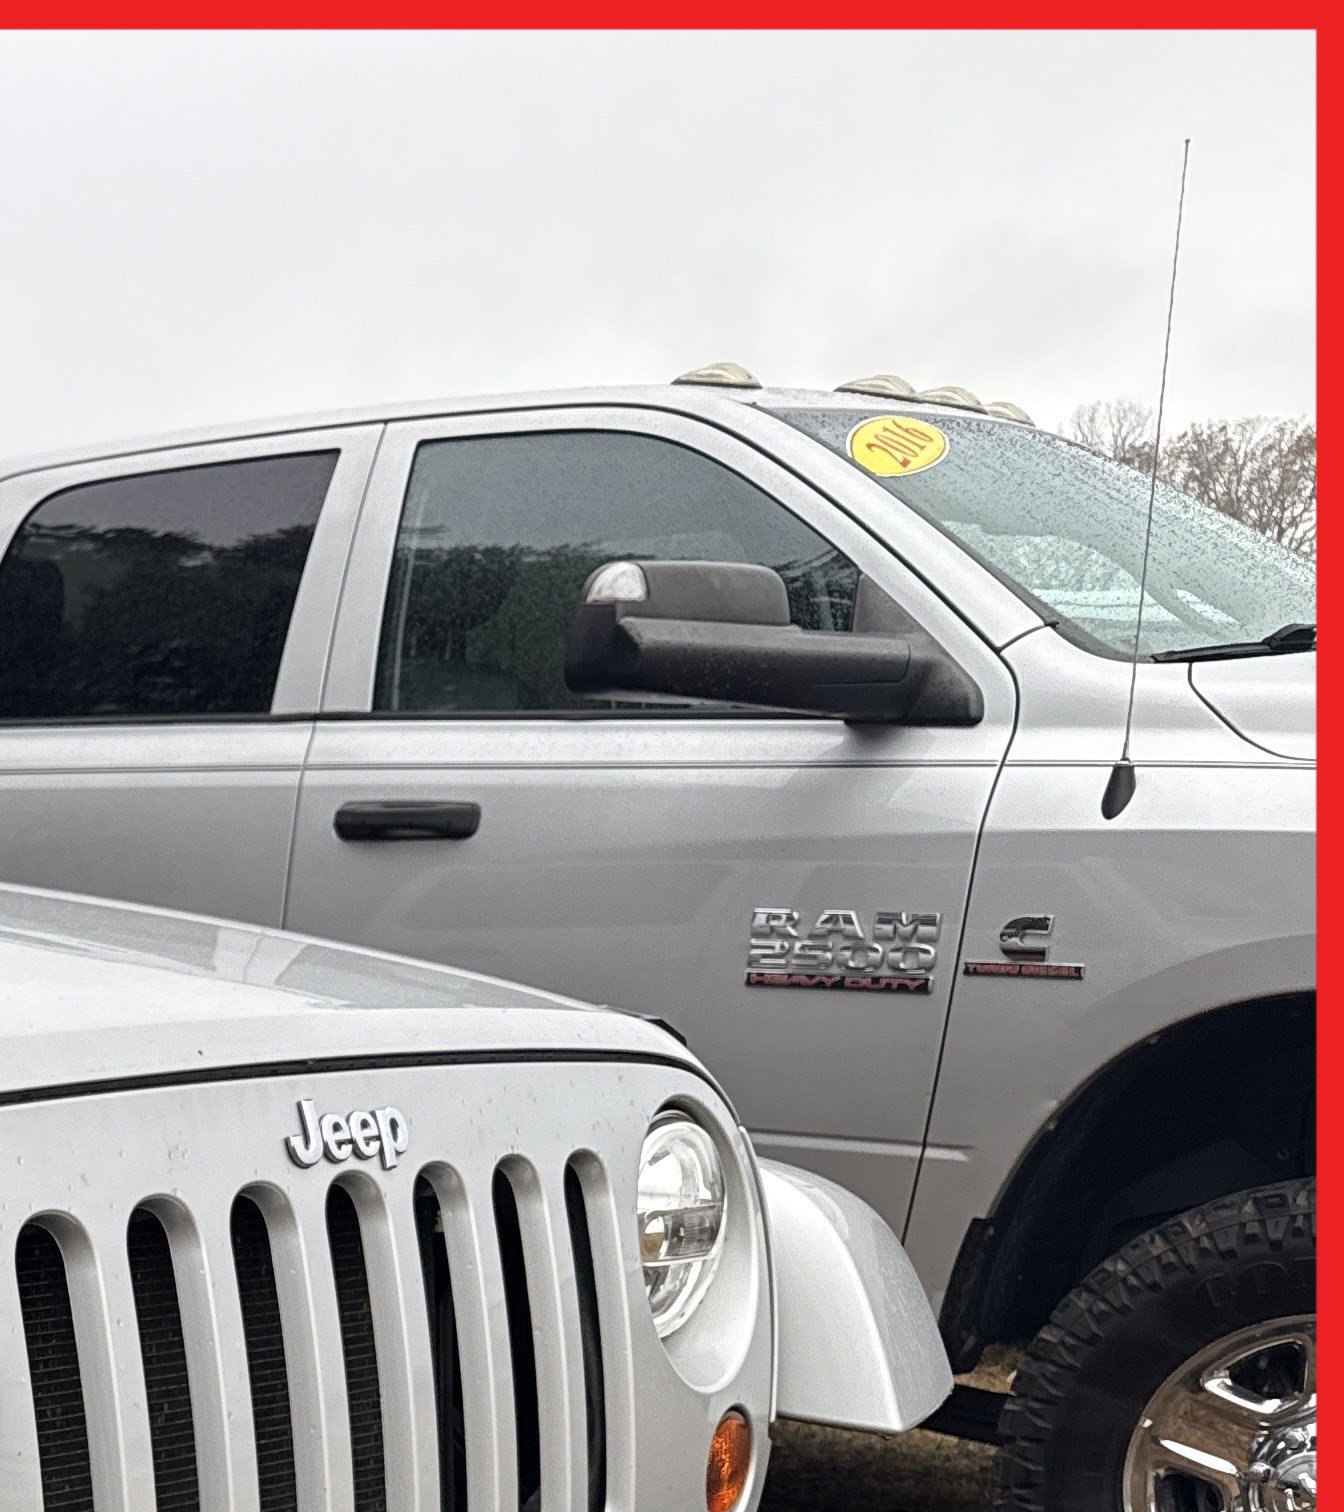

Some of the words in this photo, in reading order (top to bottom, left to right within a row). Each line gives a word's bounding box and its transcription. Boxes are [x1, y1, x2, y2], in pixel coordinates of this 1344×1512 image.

[866, 419, 933, 468] 2016
[750, 907, 942, 942] RAM
[747, 938, 938, 974] 2500
[749, 972, 842, 987] HEAVY
[844, 975, 927, 991] DUTY
[284, 1099, 409, 1170] Jeep
